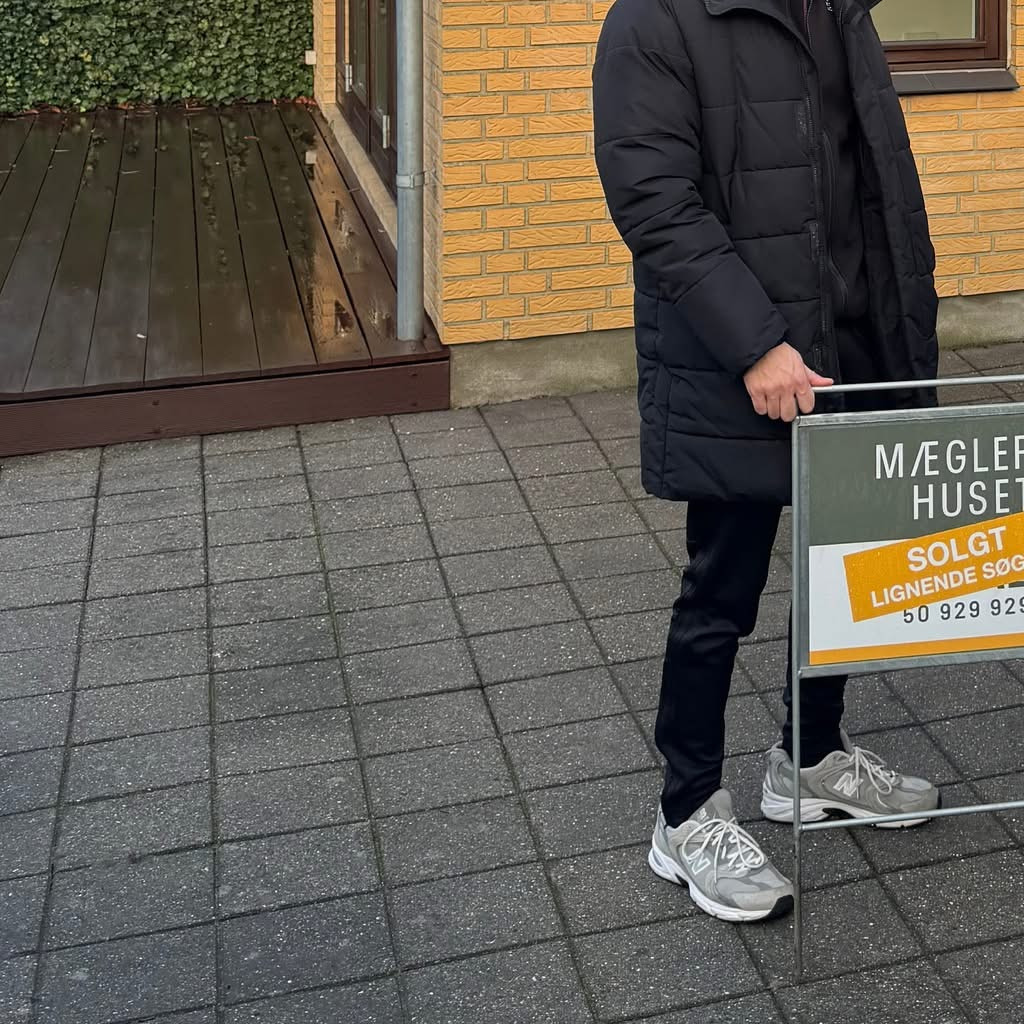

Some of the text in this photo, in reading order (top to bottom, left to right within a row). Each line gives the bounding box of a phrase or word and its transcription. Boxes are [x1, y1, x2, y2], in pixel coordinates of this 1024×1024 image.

[907, 526, 1007, 572] SOLGT
[870, 566, 978, 608] LIGNENDE
[903, 604, 929, 624] 50
[940, 600, 980, 621] 929
